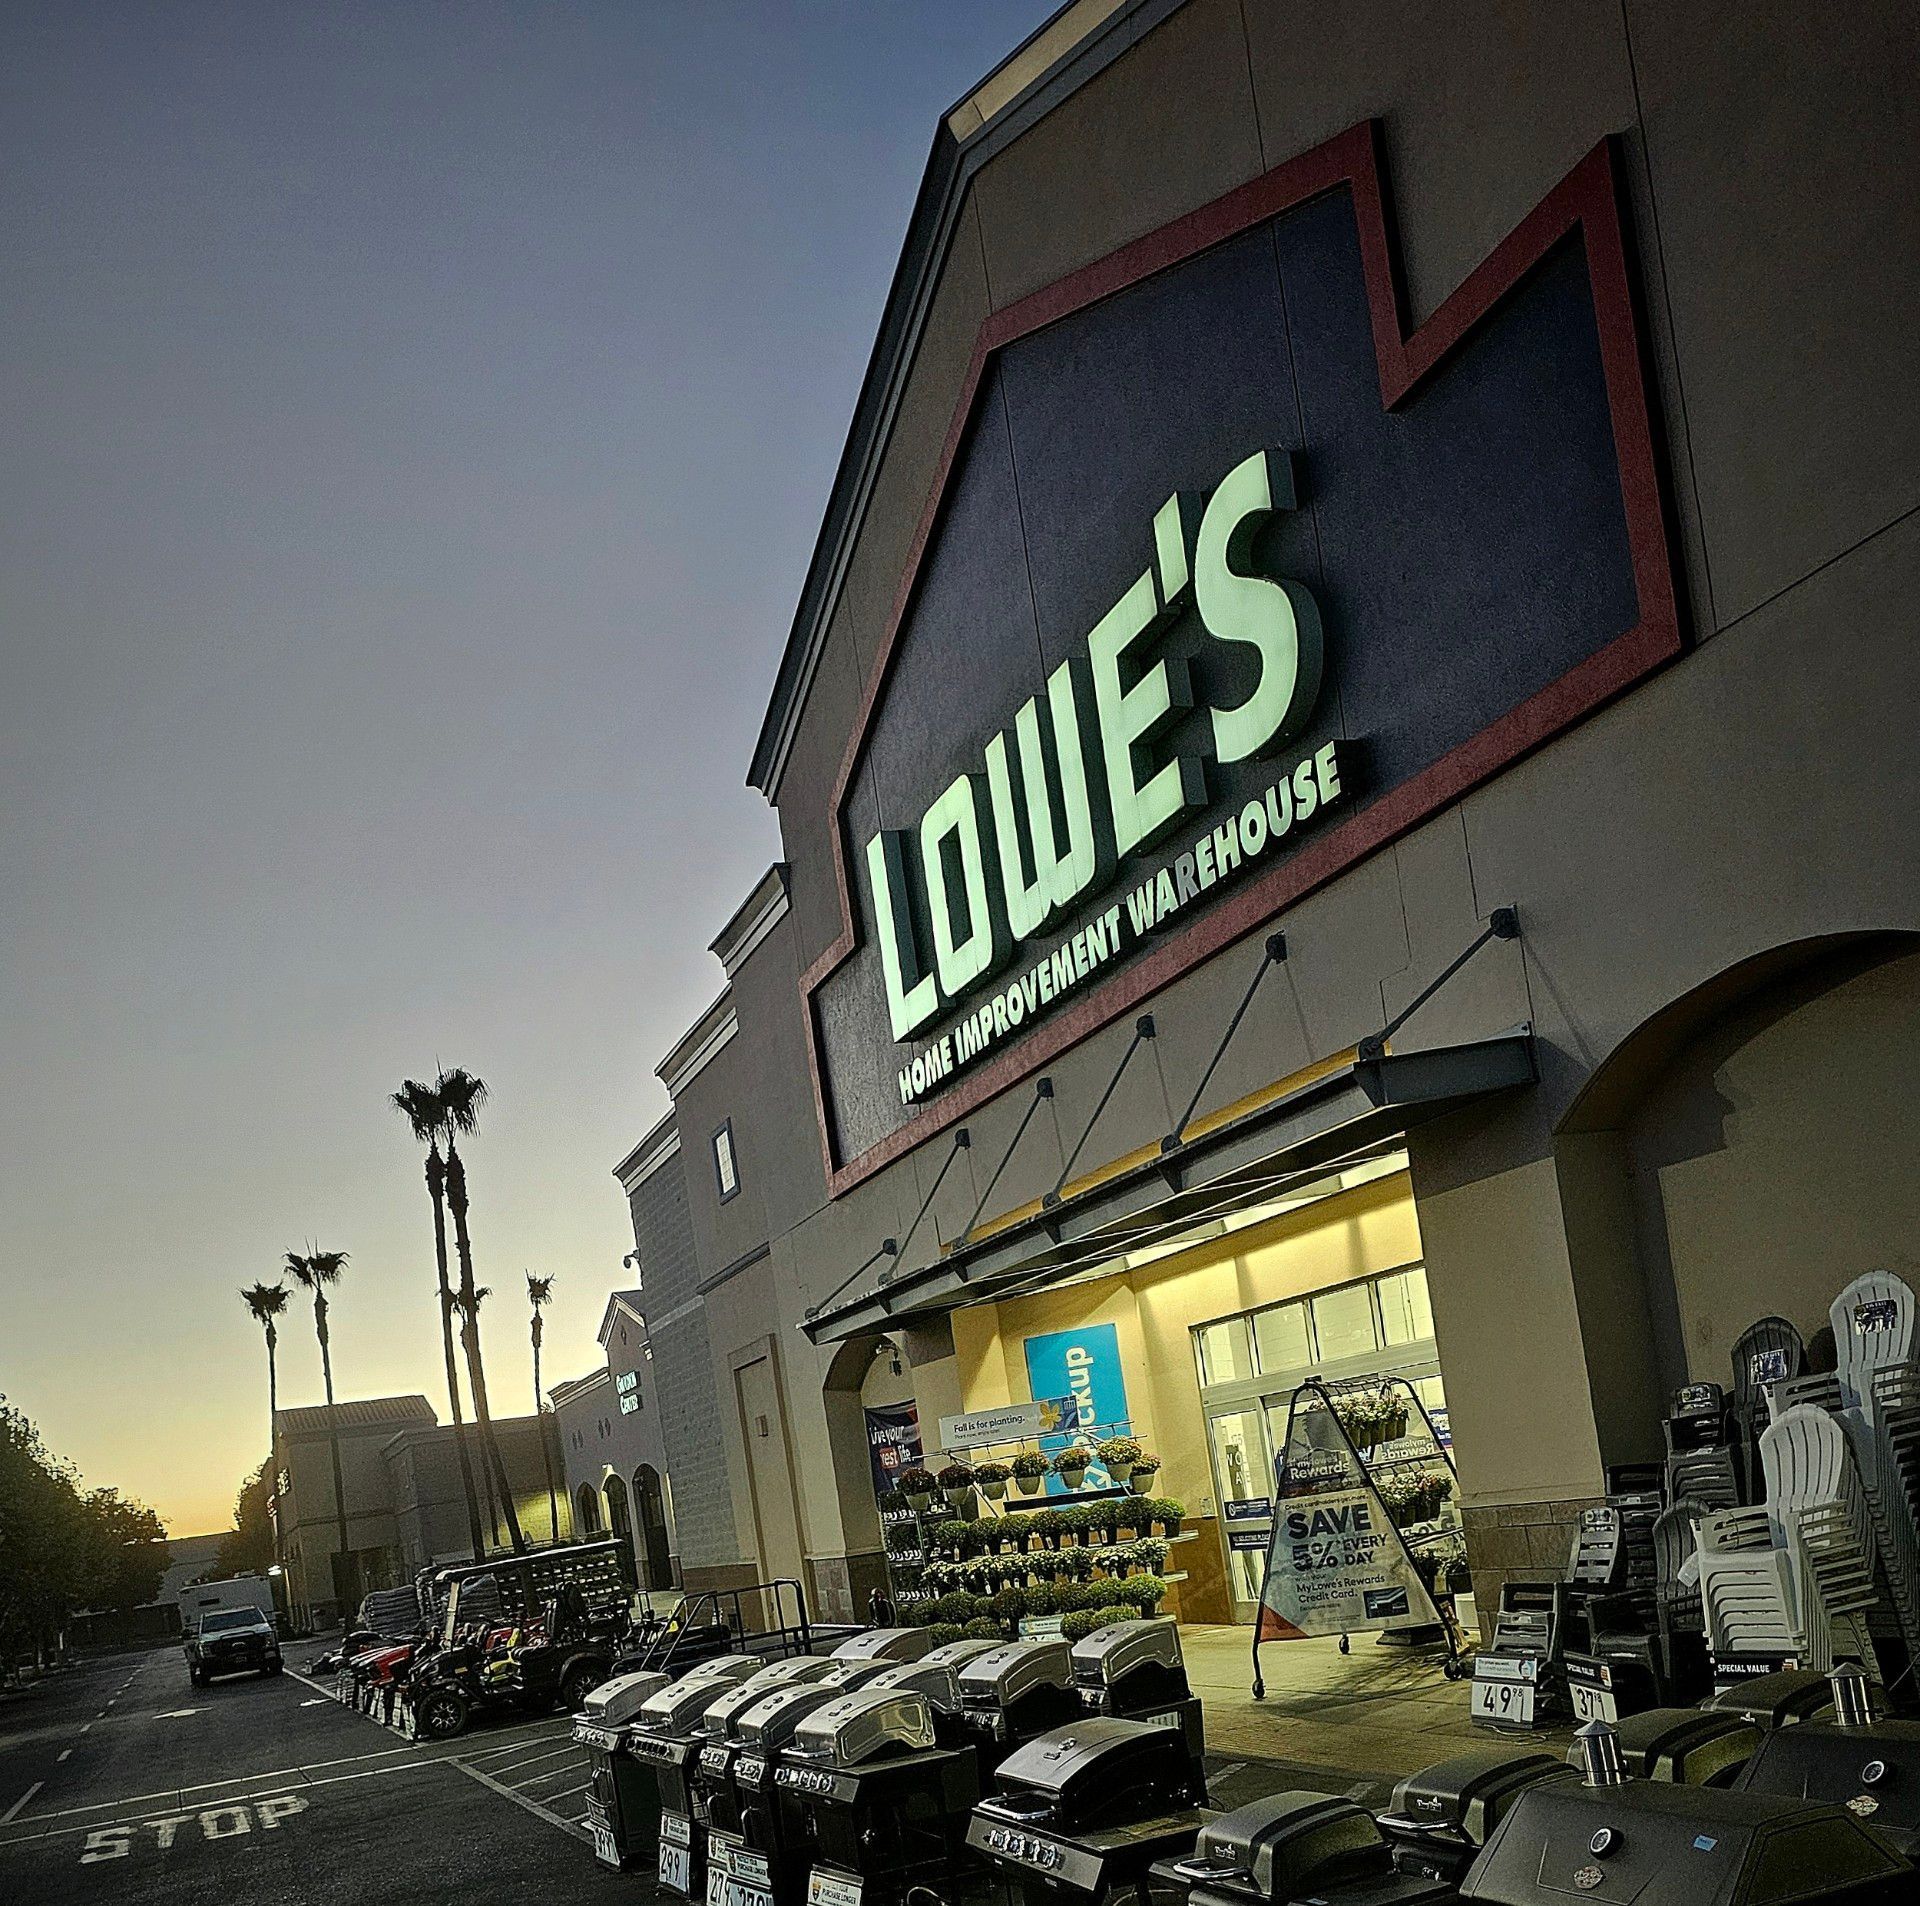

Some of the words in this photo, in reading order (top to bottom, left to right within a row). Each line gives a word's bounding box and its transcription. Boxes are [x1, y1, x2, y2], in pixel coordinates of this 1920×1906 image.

[866, 450, 1298, 1043] LOWE'S
[898, 1034, 953, 1105] HOME
[954, 905, 1120, 1065] IMPROVEMENT
[1126, 741, 1342, 937] WAREHOUSE
[954, 1423, 968, 1433] Fall
[968, 1421, 975, 1431] is
[976, 1419, 989, 1429] for
[989, 1414, 1026, 1429] planting.
[1289, 1460, 1351, 1480] Rewards
[1287, 1503, 1372, 1540] SAVE
[1342, 1533, 1388, 1552] EVERY
[1344, 1550, 1375, 1566] DAY
[1296, 1577, 1343, 1593] MyLowe's
[1343, 1573, 1386, 1587] Rewards
[1298, 1591, 1330, 1604] Credit
[1330, 1587, 1358, 1600] Card.
[1717, 1664, 1746, 1673] SPECIAL
[1746, 1664, 1770, 1673] VALUE
[78, 1795, 310, 1864] STOP
